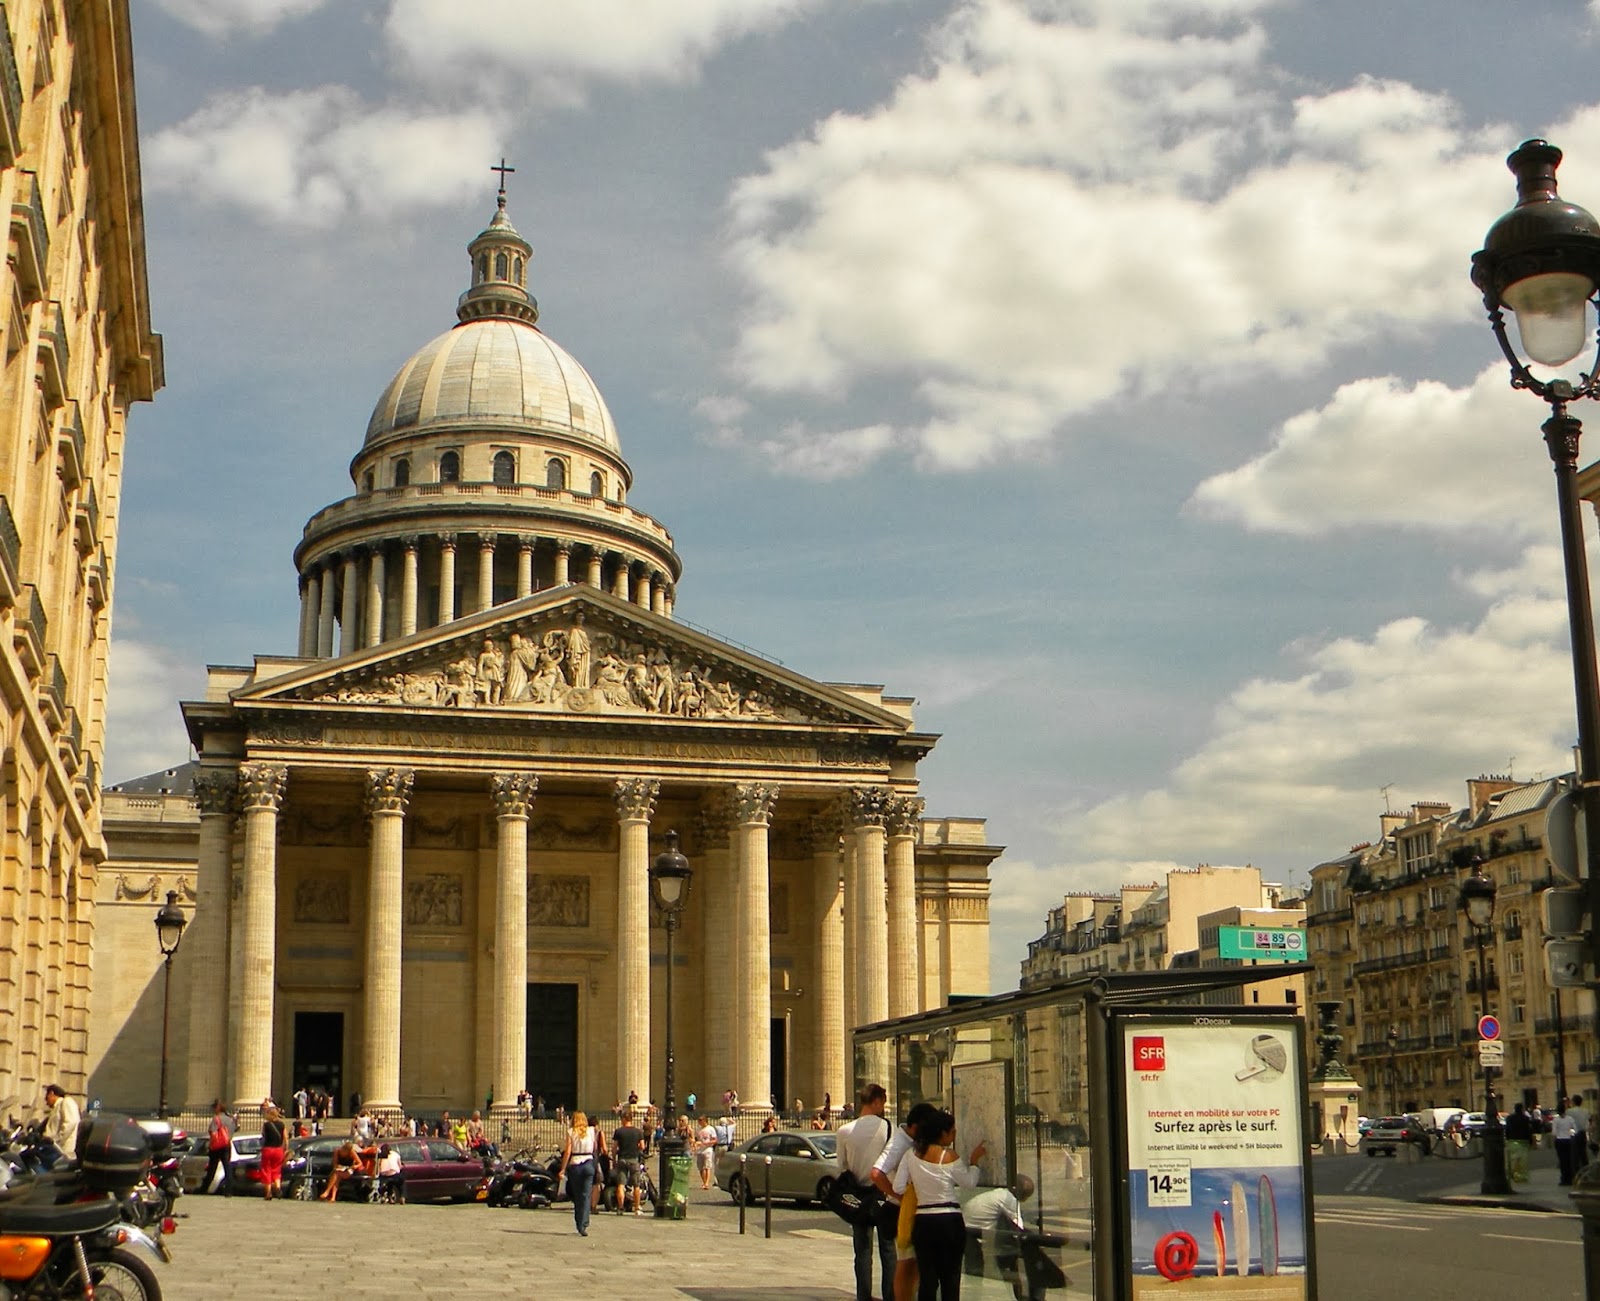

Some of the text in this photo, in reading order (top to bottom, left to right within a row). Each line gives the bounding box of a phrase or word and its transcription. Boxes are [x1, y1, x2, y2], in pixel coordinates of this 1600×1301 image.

[331, 729, 372, 745] AUX
[377, 730, 455, 748] GRANDS
[460, 733, 540, 752] HOMMES
[652, 740, 813, 763] RECONNAISSANTE
[1257, 933, 1268, 942] 84
[1272, 933, 1285, 943] 89
[1193, 1017, 1232, 1026] JCDecaux
[1140, 1047, 1165, 1060] SFR
[1140, 1073, 1160, 1082] sfr.fr
[1148, 1110, 1182, 1118] Internet
[1196, 1109, 1230, 1117] mobilité
[1247, 1109, 1268, 1117] votre
[1154, 1120, 1277, 1134] Surfez après le surf.
[1256, 1142, 1283, 1150] bloquées
